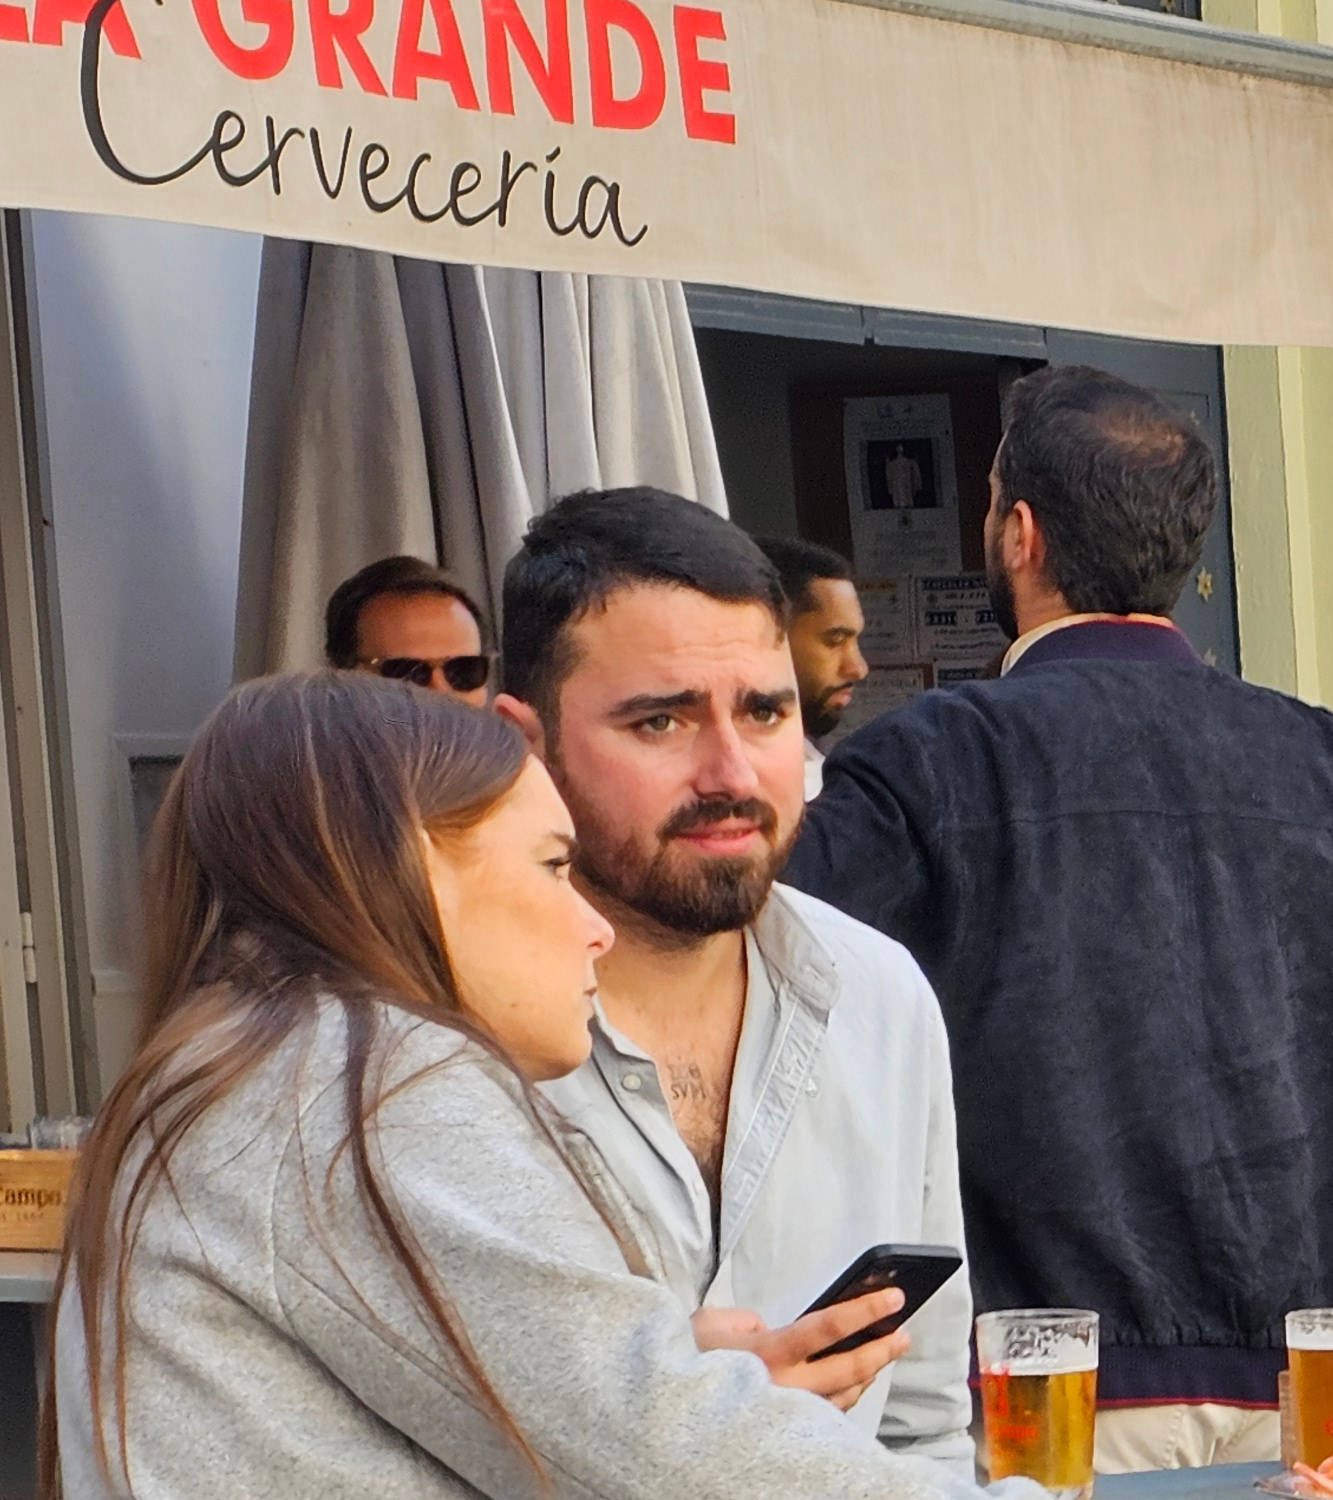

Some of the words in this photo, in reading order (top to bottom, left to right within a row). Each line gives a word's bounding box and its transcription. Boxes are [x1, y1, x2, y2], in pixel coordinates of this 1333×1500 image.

[80, 0, 648, 247] Cervecería
[190, 0, 737, 145] GRANDE
[0, 1187, 61, 1210] ampo
